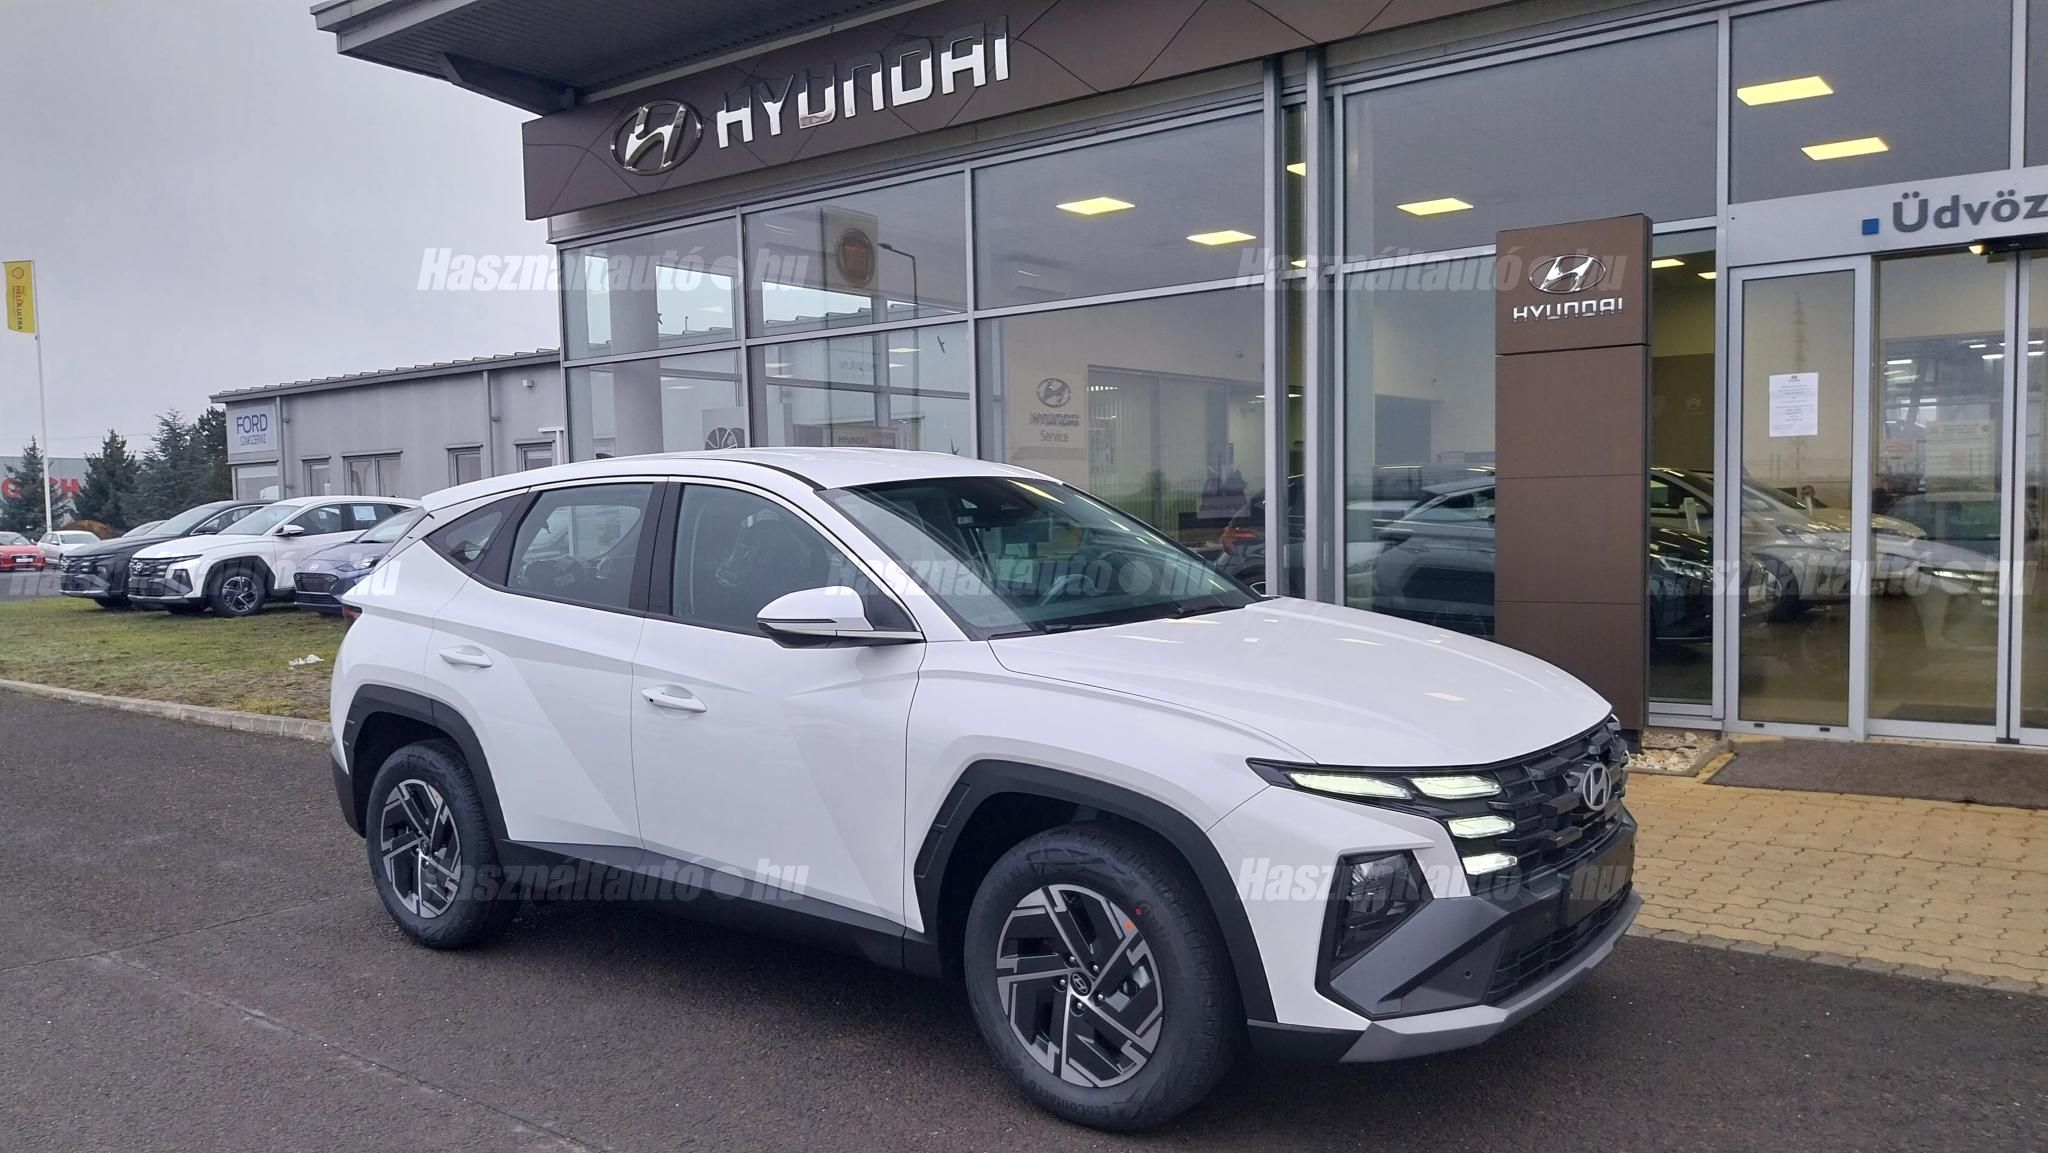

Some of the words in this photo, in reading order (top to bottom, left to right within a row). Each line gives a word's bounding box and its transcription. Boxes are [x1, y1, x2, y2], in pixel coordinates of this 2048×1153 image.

[716, 15, 1009, 148] HYUNDAI
[1892, 189, 2048, 233] Üdvöz
[1512, 297, 1624, 323] HYUNDAI
[236, 413, 268, 434] FORD
